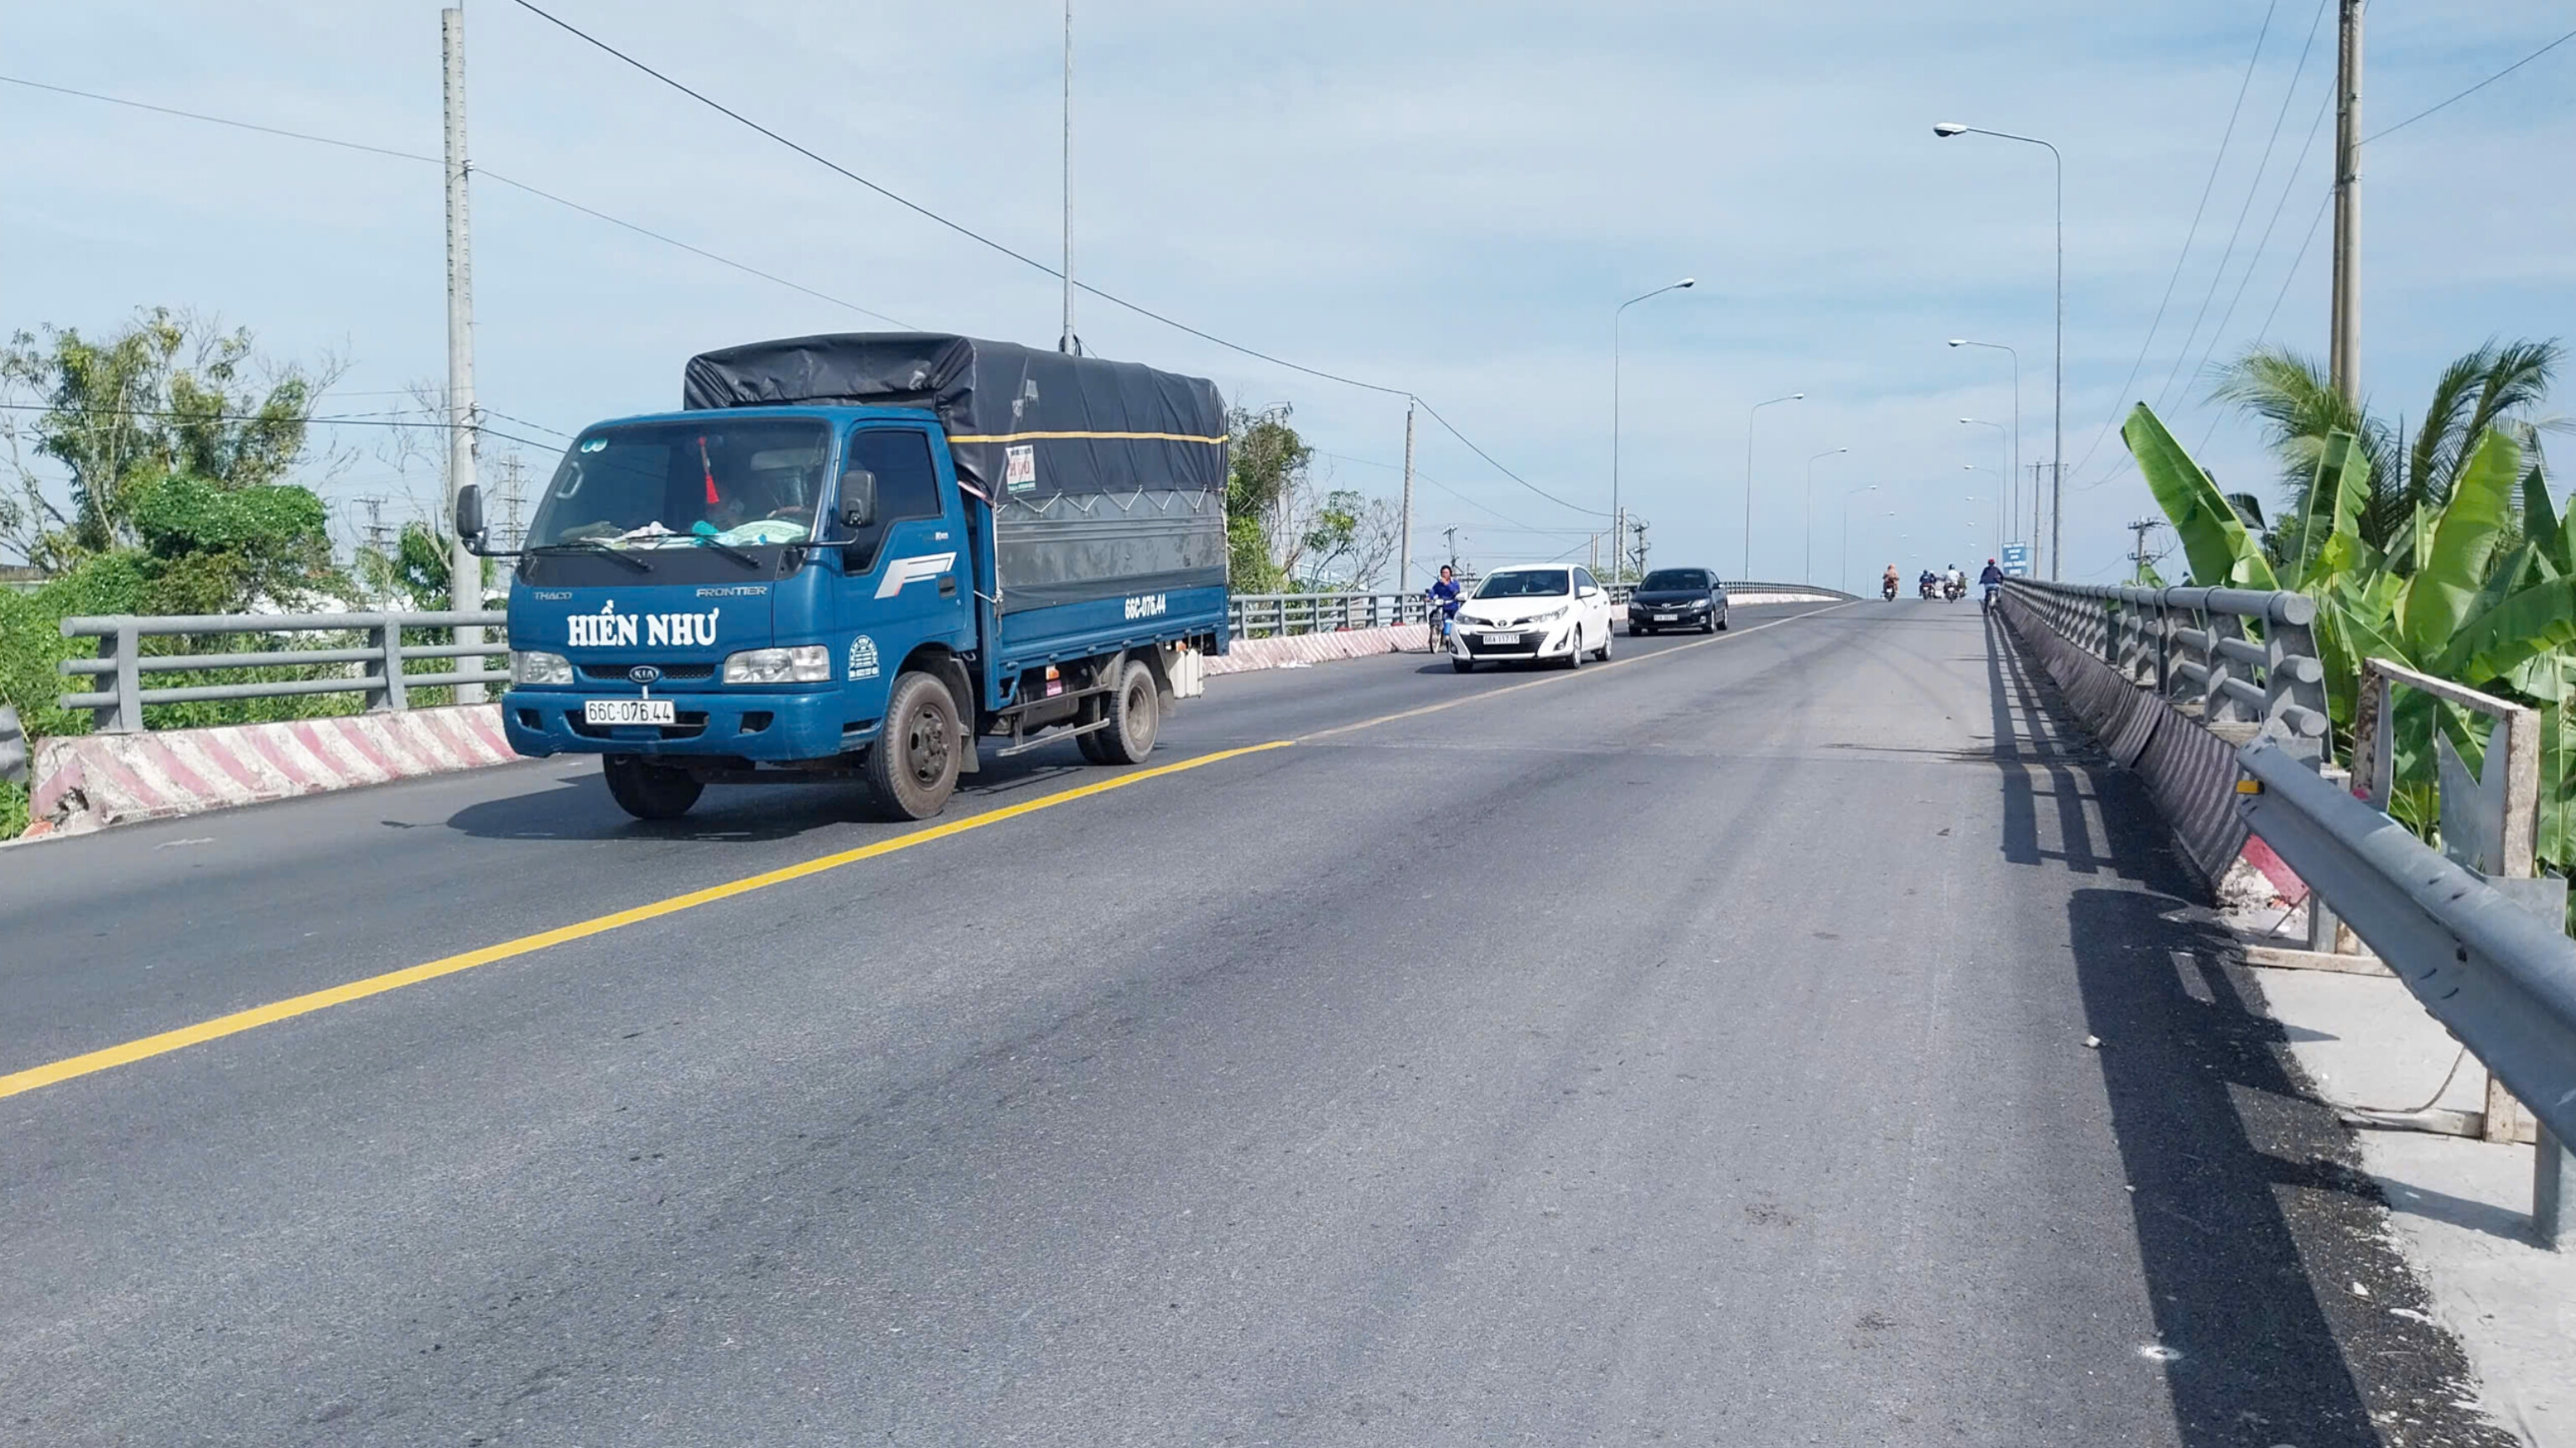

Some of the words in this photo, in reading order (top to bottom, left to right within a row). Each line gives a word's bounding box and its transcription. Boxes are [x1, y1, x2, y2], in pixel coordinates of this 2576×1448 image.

[534, 591, 573, 600] THACO
[695, 585, 768, 598] FRONTIER
[1124, 593, 1166, 620] 66C-076.44
[645, 606, 719, 646] NHƯ
[633, 669, 655, 679] KIA
[588, 702, 672, 722] 66C-076.44
